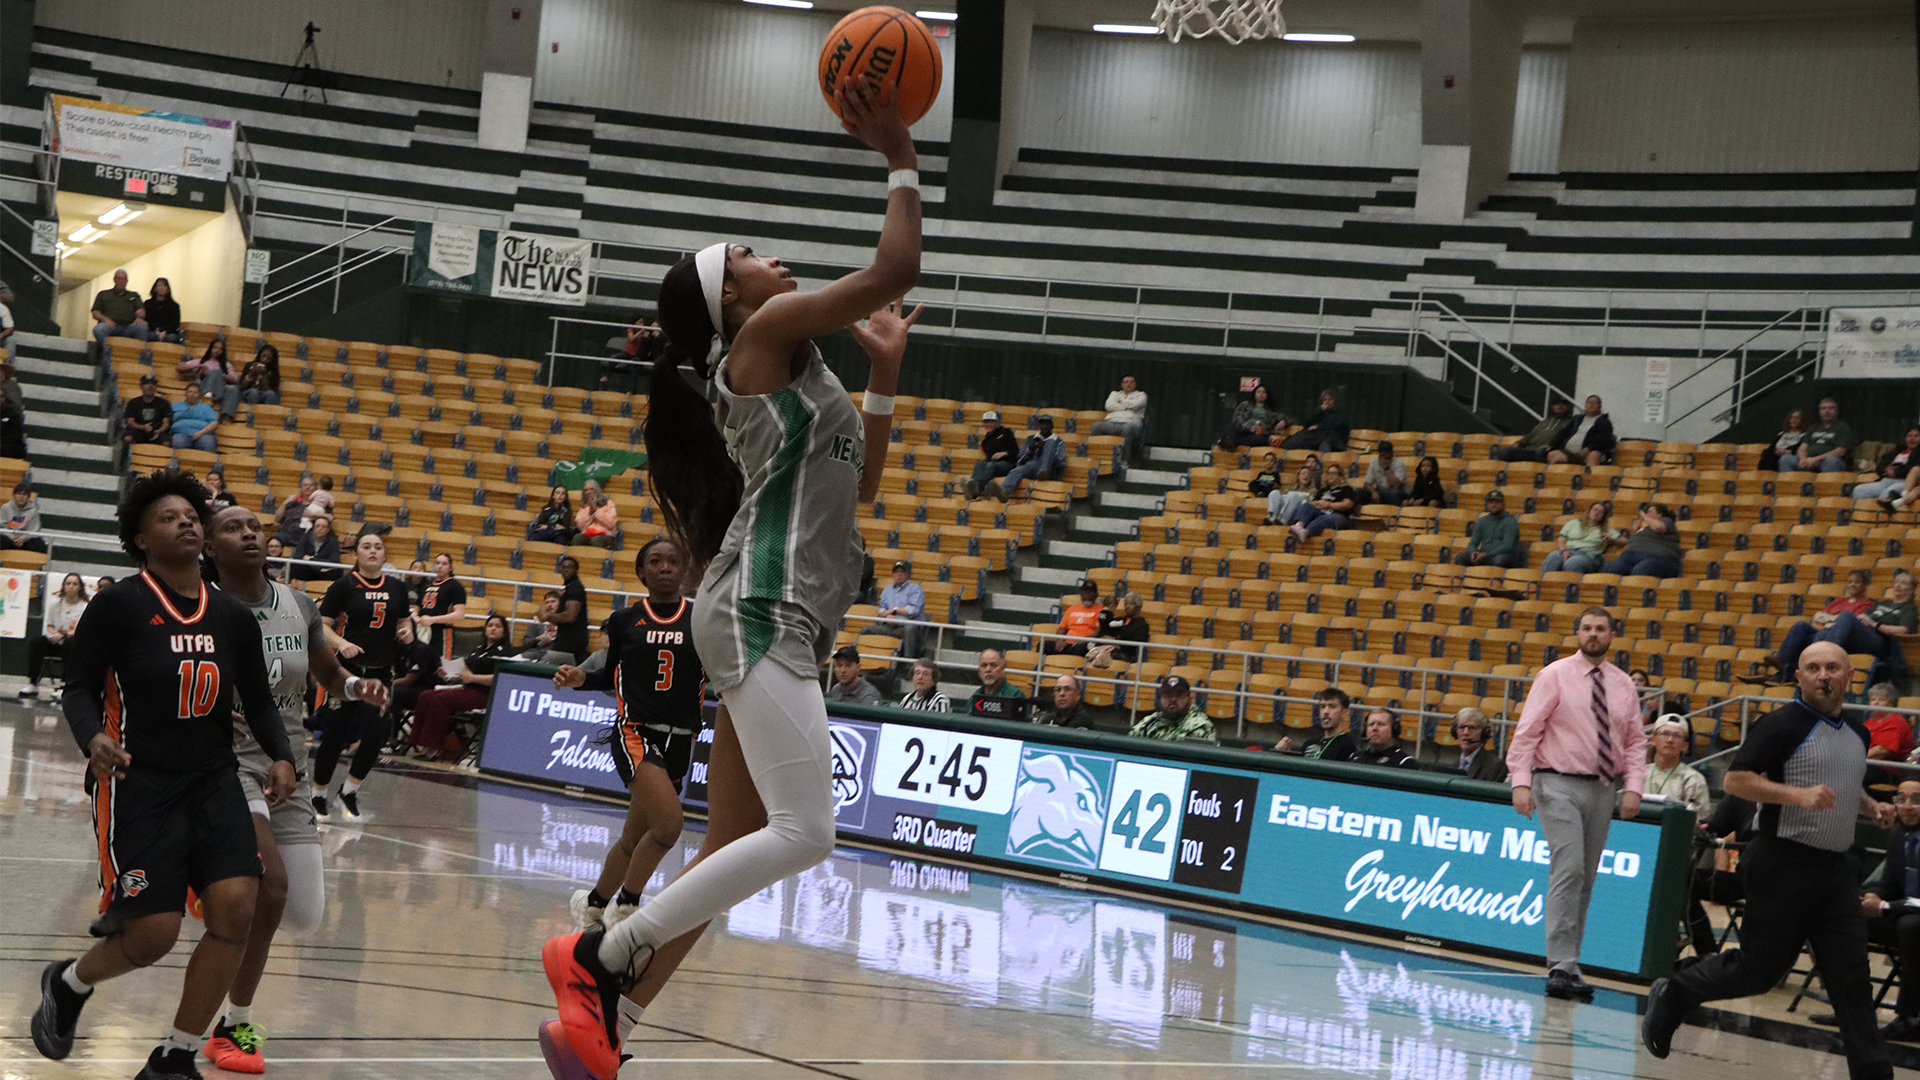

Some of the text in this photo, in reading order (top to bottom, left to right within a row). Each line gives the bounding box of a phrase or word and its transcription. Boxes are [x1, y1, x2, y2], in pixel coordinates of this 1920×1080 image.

[824, 36, 854, 97] NCAA
[65, 110, 95, 124] Score
[97, 116, 106, 125] a
[95, 164, 178, 188] RESTROOMS
[251, 251, 266, 260] NO
[502, 235, 554, 267] The
[499, 260, 583, 295] NEWS
[369, 602, 387, 629] 5
[421, 591, 439, 609] 45
[170, 634, 215, 653] UTPB
[264, 633, 303, 653] TERN
[646, 630, 684, 645] UTPB
[654, 649, 675, 691] 3
[177, 659, 220, 719] 10
[508, 688, 618, 726] UT Permian
[690, 762, 708, 785] TOL
[897, 737, 991, 801] 2:45
[1111, 789, 1172, 854] 42
[1187, 790, 1244, 823] Fouls 1
[892, 814, 977, 853] 3RD Quarter
[1268, 794, 1641, 878] Eastern New Meco
[1180, 839, 1236, 872] TOL 2
[1344, 849, 1544, 926] Greyhounds
